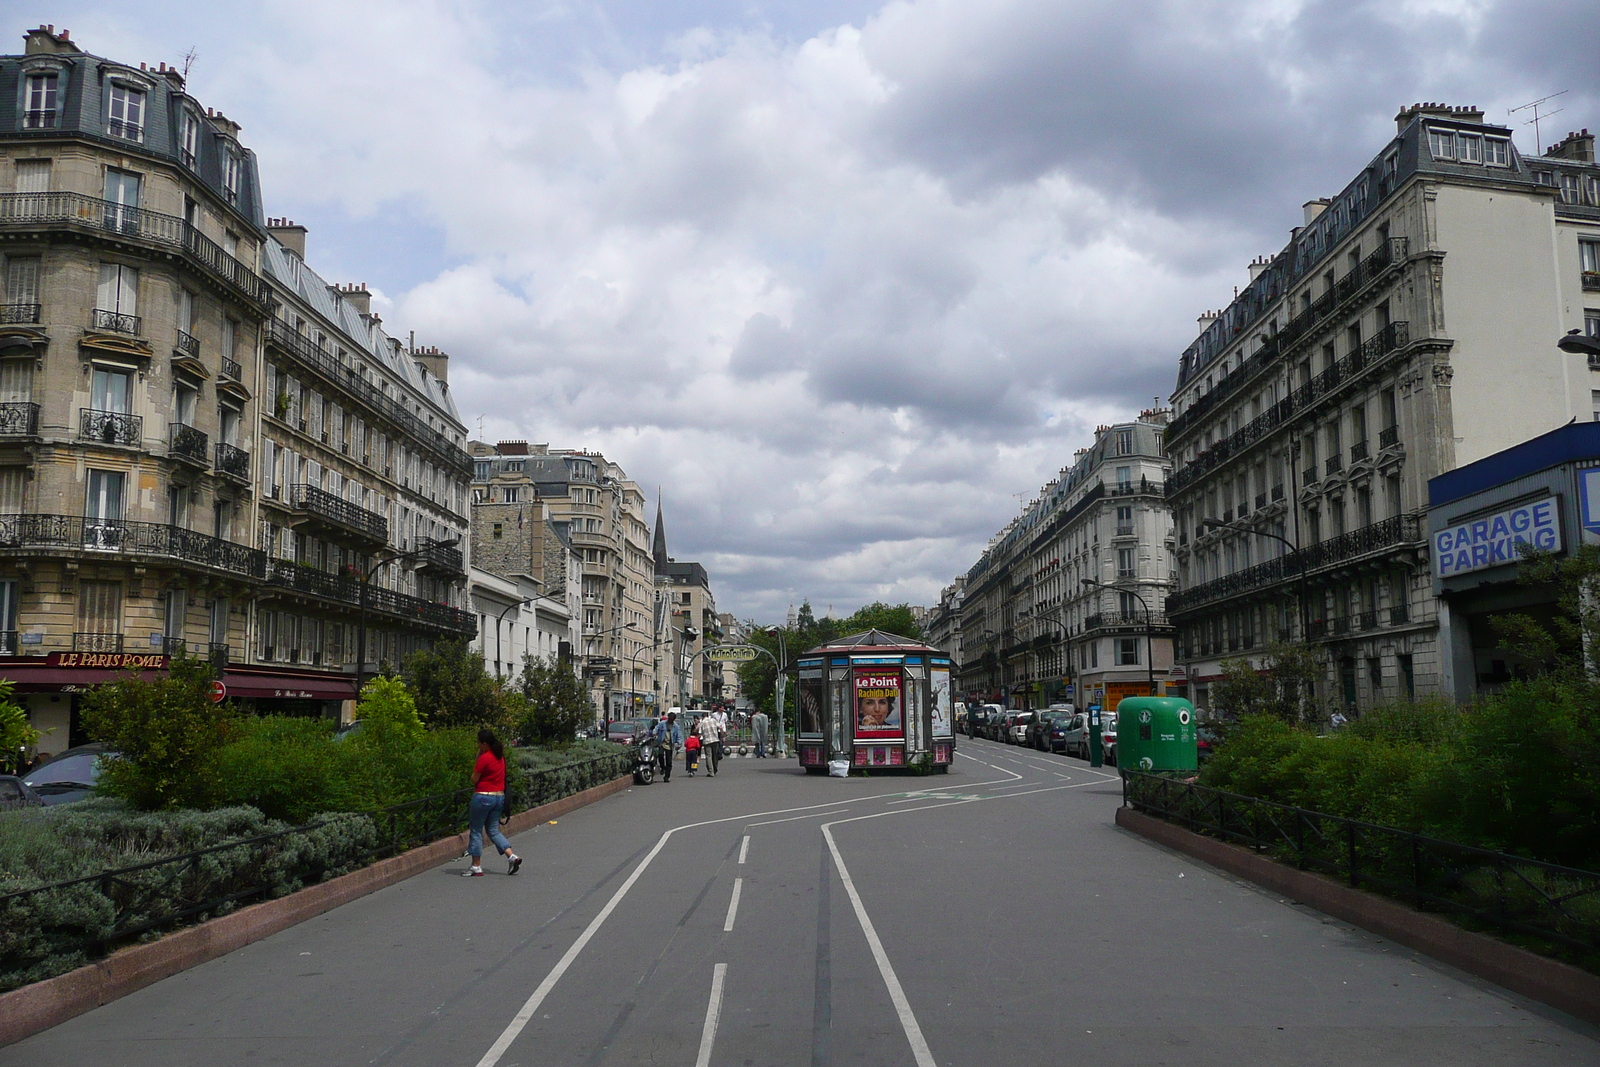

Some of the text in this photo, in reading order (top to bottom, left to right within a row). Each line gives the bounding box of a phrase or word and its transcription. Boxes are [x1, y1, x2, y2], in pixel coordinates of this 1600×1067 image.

[1436, 501, 1552, 553] GARAGE
[1439, 528, 1556, 575] PARKING
[58, 652, 164, 668] LE PARIS ROME
[856, 677, 897, 686] Le Point
[858, 689, 898, 698] Rachida Dati
